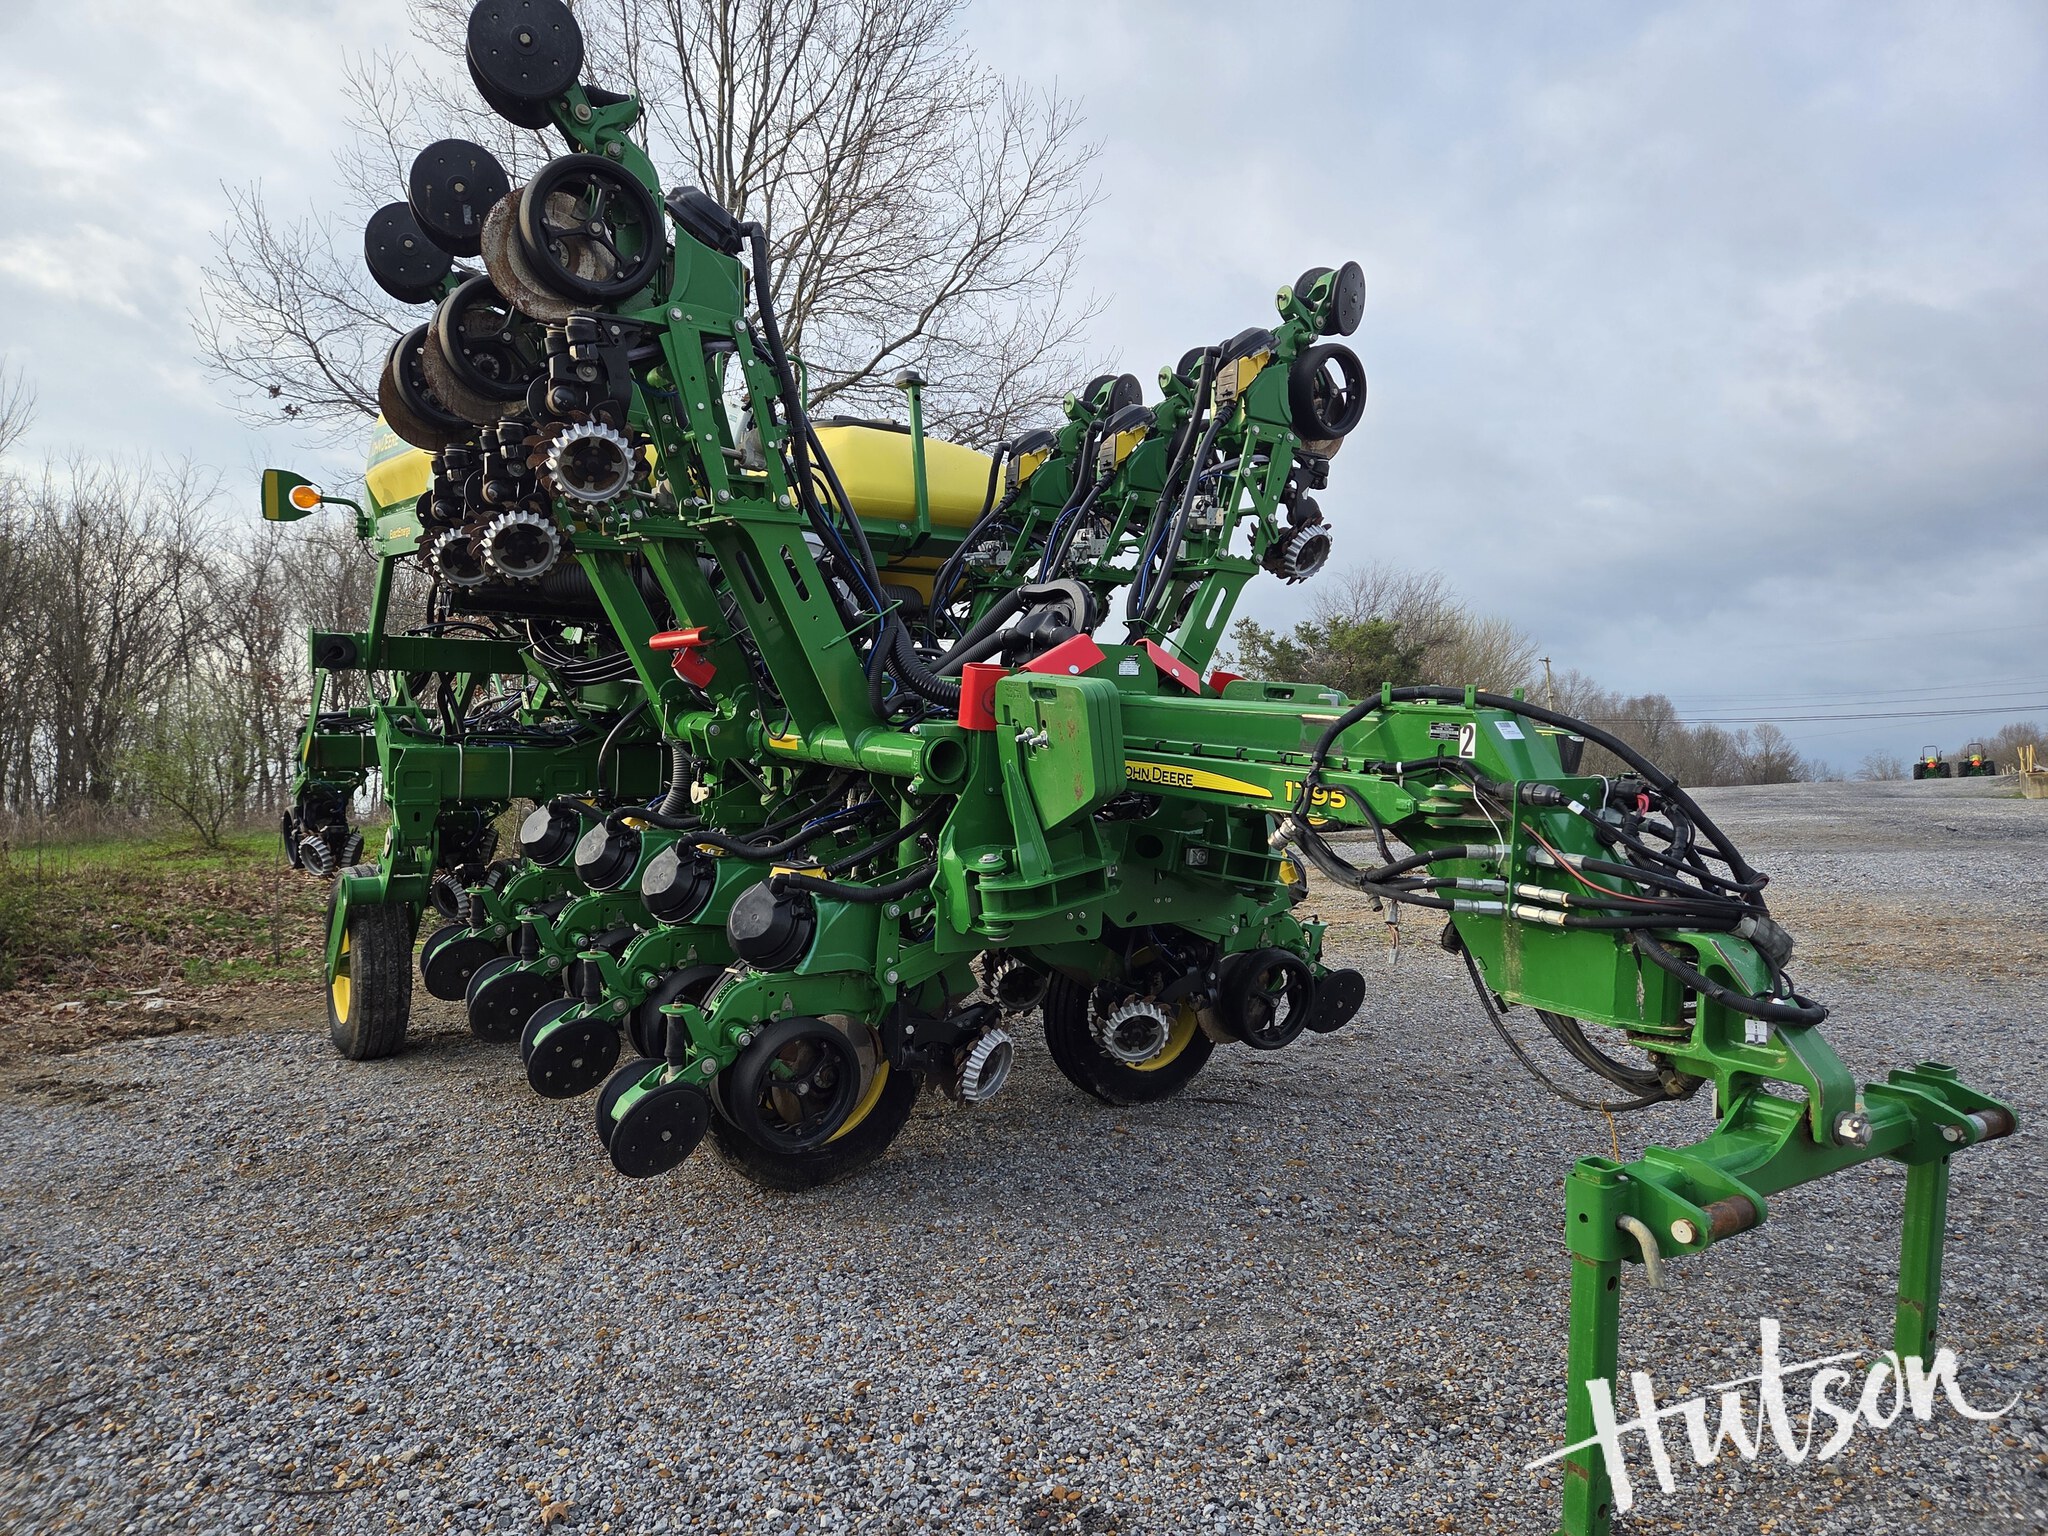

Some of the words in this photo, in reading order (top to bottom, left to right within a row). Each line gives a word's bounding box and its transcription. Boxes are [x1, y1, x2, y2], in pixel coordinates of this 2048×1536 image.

[1461, 724, 1475, 757] 2
[1125, 765, 1150, 781] OHN
[1152, 766, 1194, 787] DEERE
